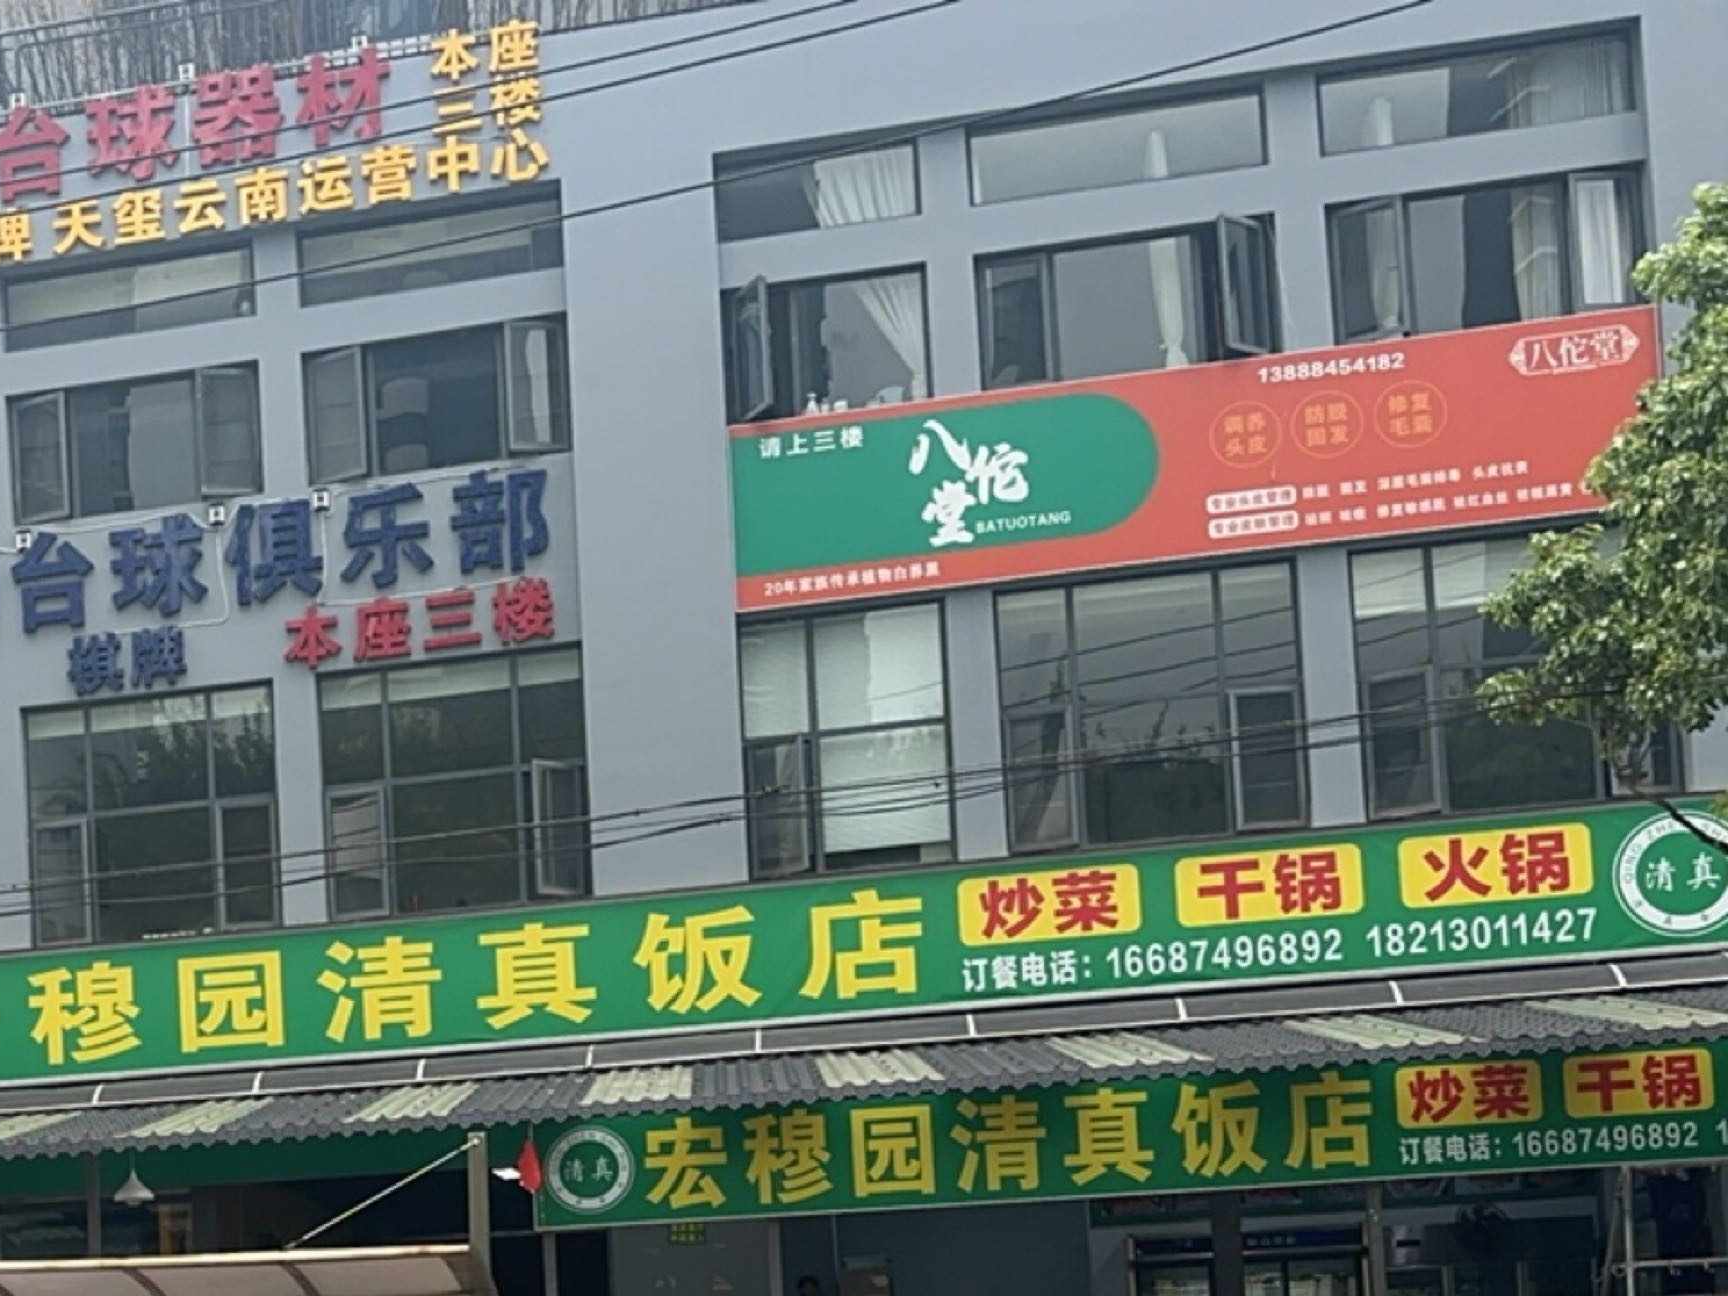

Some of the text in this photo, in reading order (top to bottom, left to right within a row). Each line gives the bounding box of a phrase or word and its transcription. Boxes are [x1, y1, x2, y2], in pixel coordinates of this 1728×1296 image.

[430, 18, 540, 81] 本座
[432, 71, 542, 135] 三楼
[52, 127, 550, 256] 天玺云南运营中心
[1257, 352, 1406, 384] 13888454182
[758, 426, 864, 460] 请上三楼
[975, 511, 1072, 535] BATUOTANG
[282, 576, 556, 671] 本座三楼
[67, 623, 189, 697] 棋牌
[1197, 851, 1342, 920] 干锅
[1424, 829, 1571, 903] 火锅
[1646, 852, 1721, 892] 清真
[979, 870, 1120, 940] 炒菜
[1366, 907, 1598, 958] 18213011427
[1408, 1060, 1531, 1124] 炒菜
[1576, 1055, 1702, 1113] 干锅
[563, 1155, 614, 1182] 清真
[643, 1071, 1372, 1209] 宏穆园清真饭店
